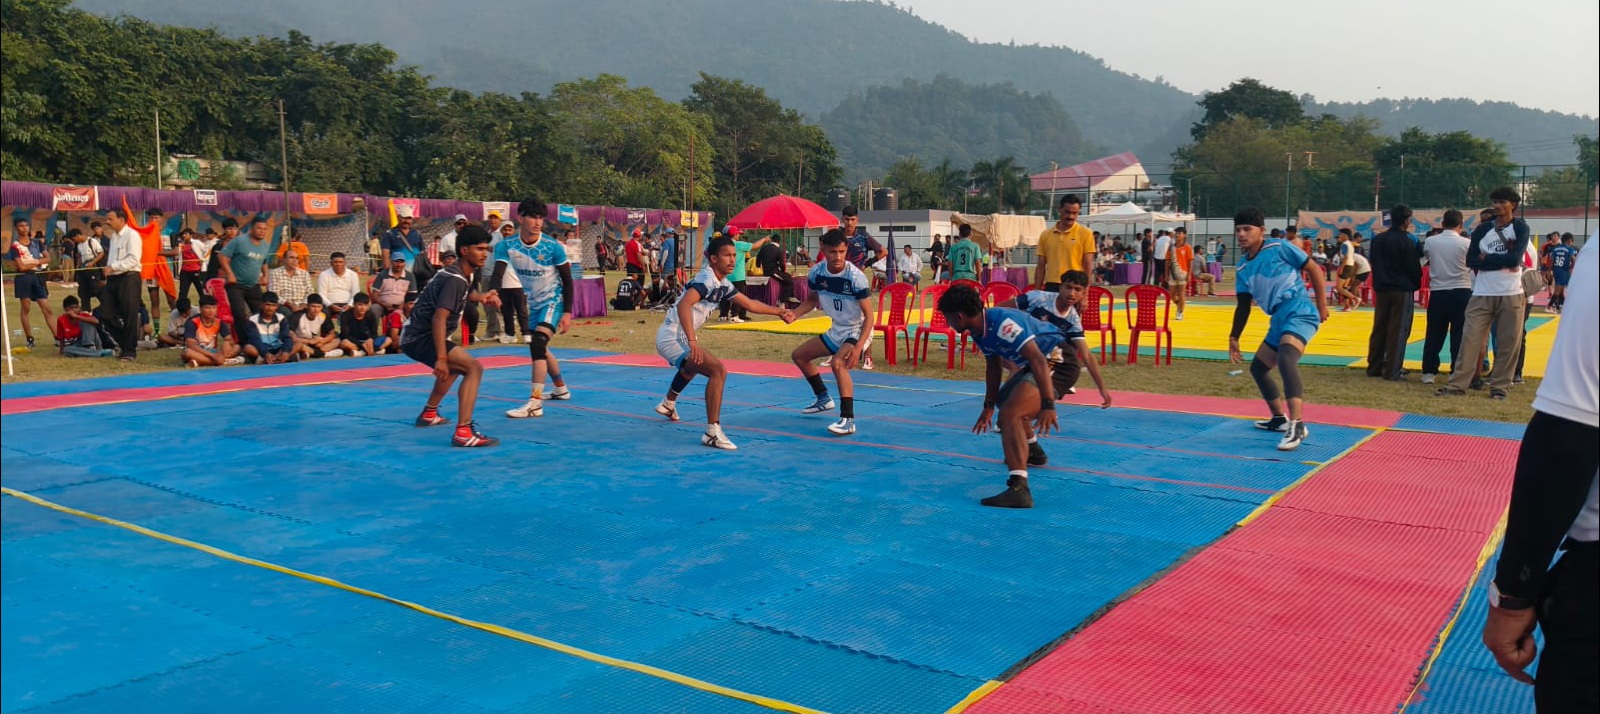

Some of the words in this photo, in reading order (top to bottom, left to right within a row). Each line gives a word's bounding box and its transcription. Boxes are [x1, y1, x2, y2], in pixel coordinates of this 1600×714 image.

[960, 253, 966, 266] 3
[620, 284, 628, 292] 21
[833, 298, 843, 312] 07
